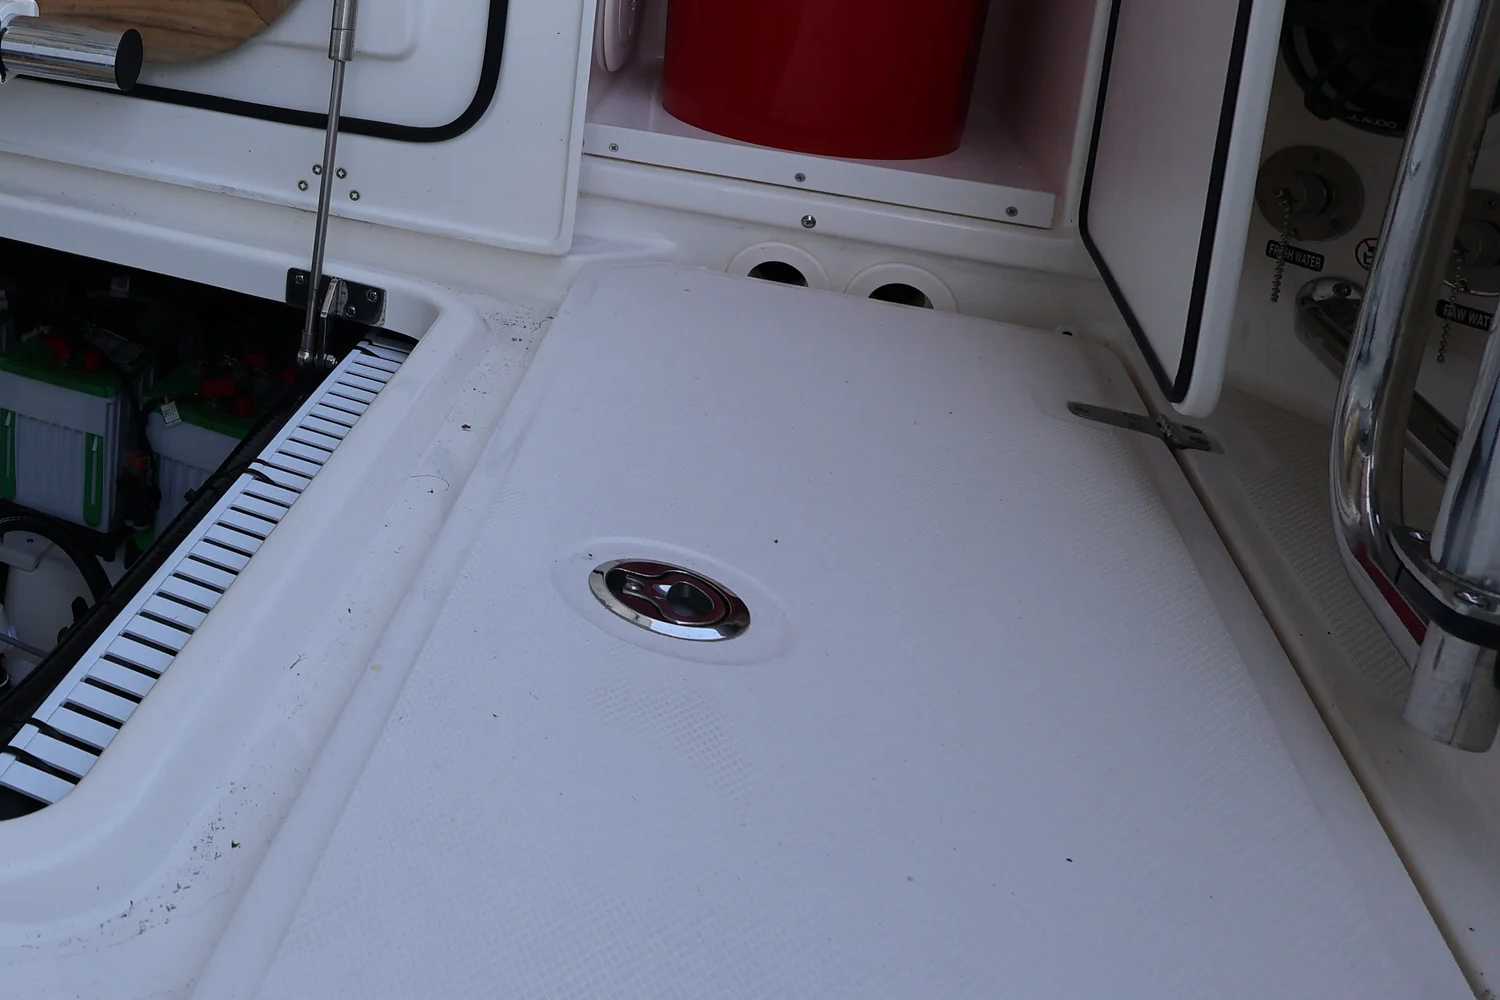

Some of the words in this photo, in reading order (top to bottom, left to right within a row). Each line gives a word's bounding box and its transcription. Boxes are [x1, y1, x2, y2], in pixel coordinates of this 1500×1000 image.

[1347, 113, 1360, 121] JL
[1361, 116, 1397, 129] AUDIO
[1269, 243, 1294, 261] FRSH
[1294, 250, 1321, 270] WATER
[1468, 310, 1490, 329] WAT
